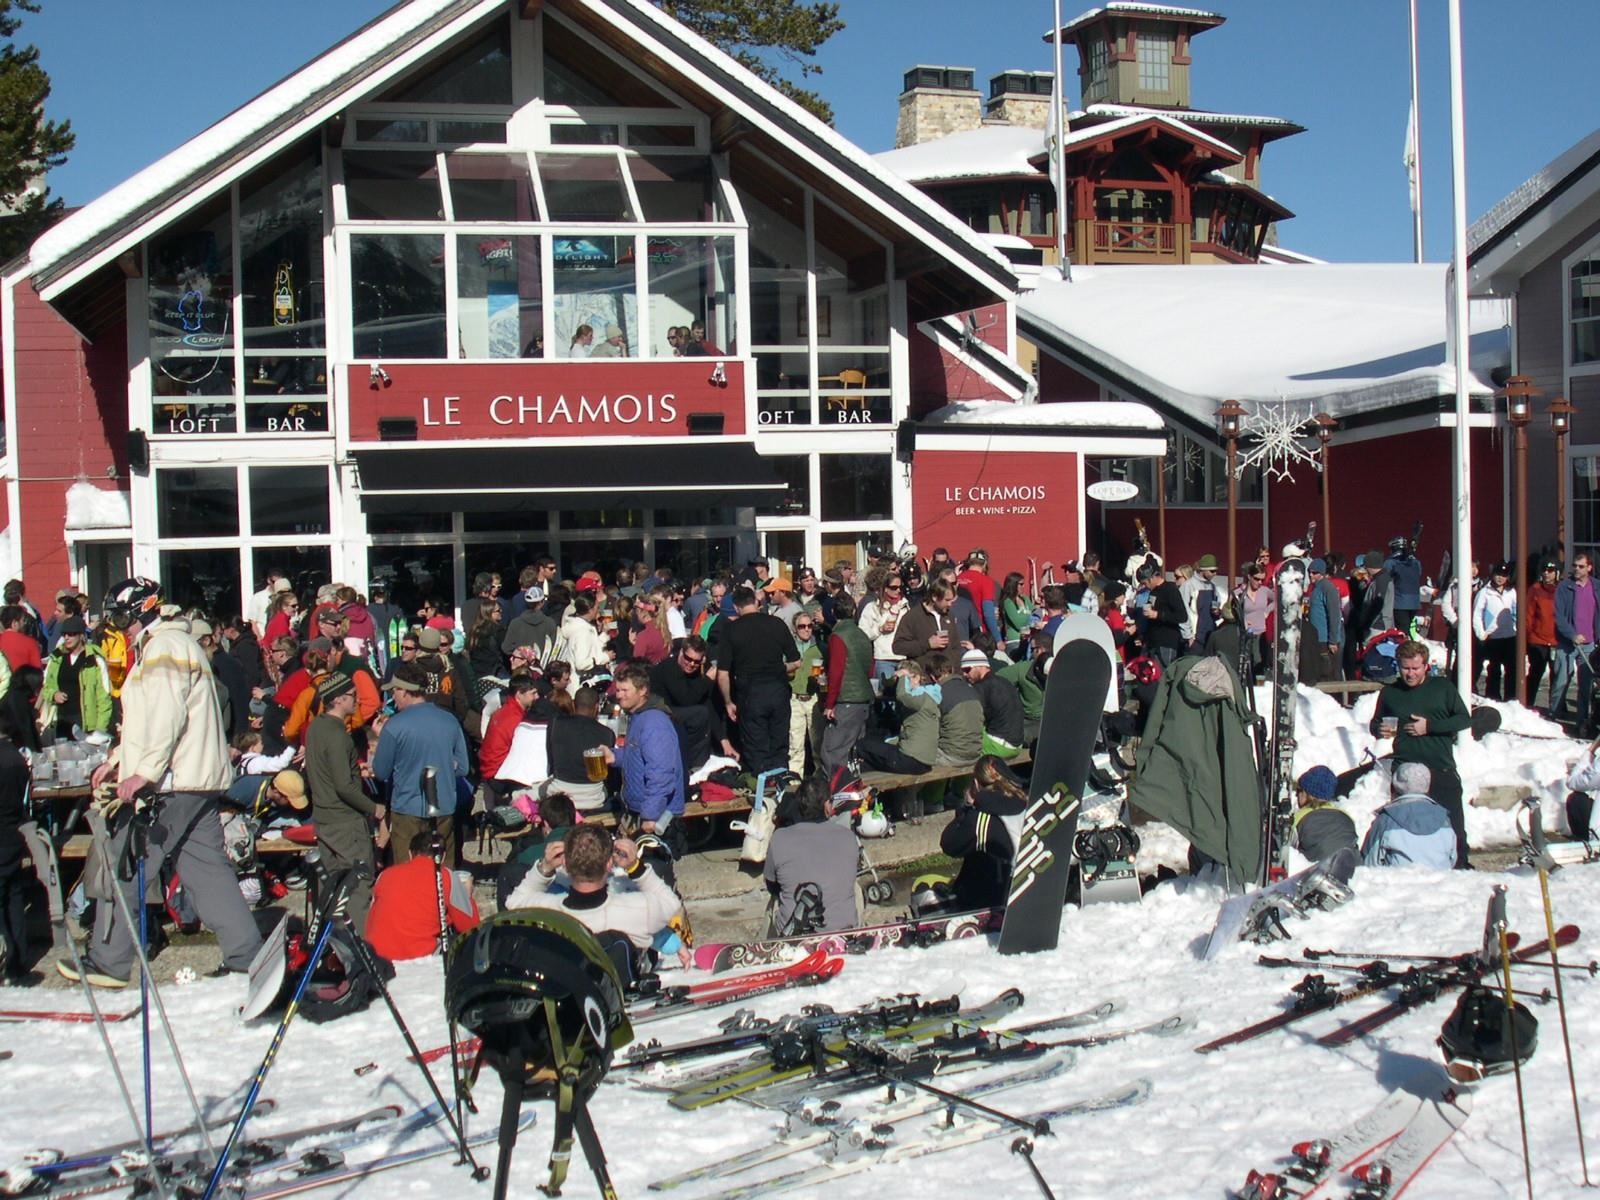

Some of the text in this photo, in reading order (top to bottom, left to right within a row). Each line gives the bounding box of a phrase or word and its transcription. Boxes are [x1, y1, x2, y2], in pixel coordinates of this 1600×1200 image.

[422, 393, 678, 426] LE CHAMOIS
[758, 409, 873, 424] OFT BAR
[169, 417, 306, 433] LOFT BAR
[945, 485, 1046, 502] LE CHAMOIS
[955, 506, 1037, 516] BEER WINE PIZZA
[307, 907, 322, 946] SCOTT
